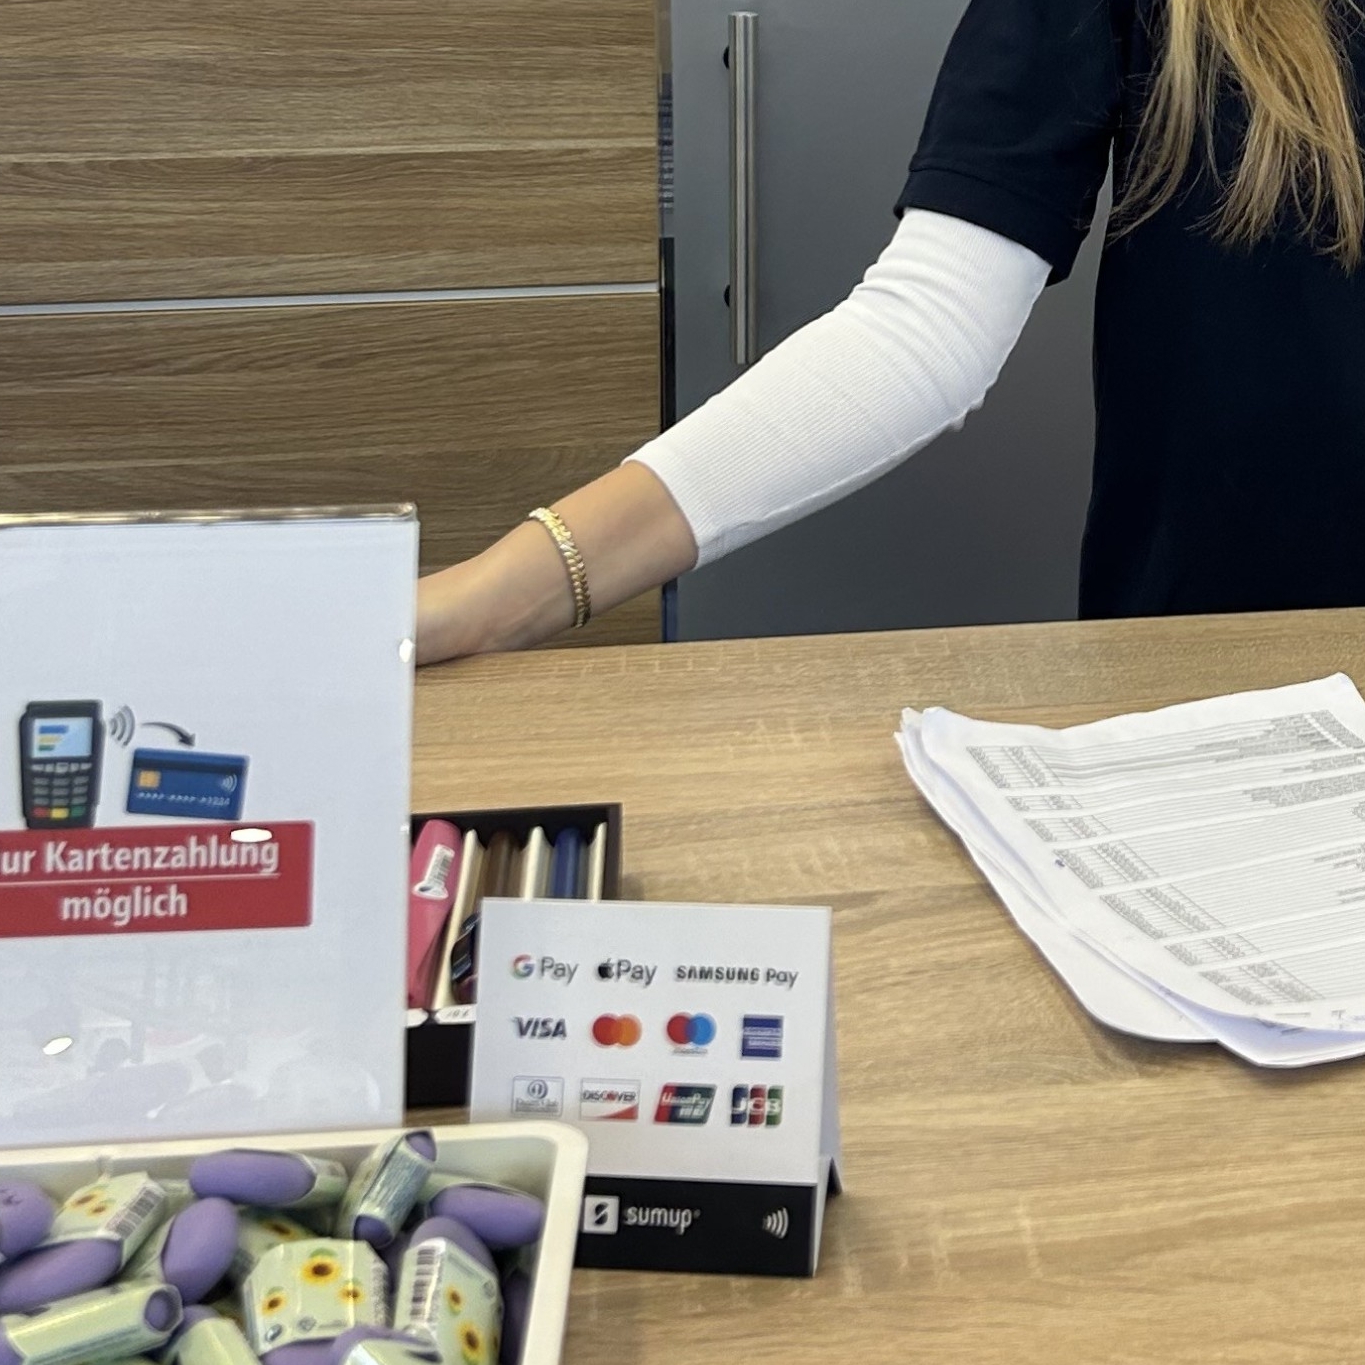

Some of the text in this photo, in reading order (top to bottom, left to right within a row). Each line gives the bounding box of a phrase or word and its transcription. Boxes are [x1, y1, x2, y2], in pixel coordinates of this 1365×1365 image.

[44, 834, 280, 875] Kartenzahlung
[61, 884, 189, 927] möglich
[540, 956, 579, 984] Pay
[616, 958, 657, 987] Pay
[676, 965, 799, 988] SAMSUNG Pay
[515, 1017, 567, 1038] VISA
[731, 1095, 783, 1113] JCB
[624, 1204, 694, 1235] sumup
